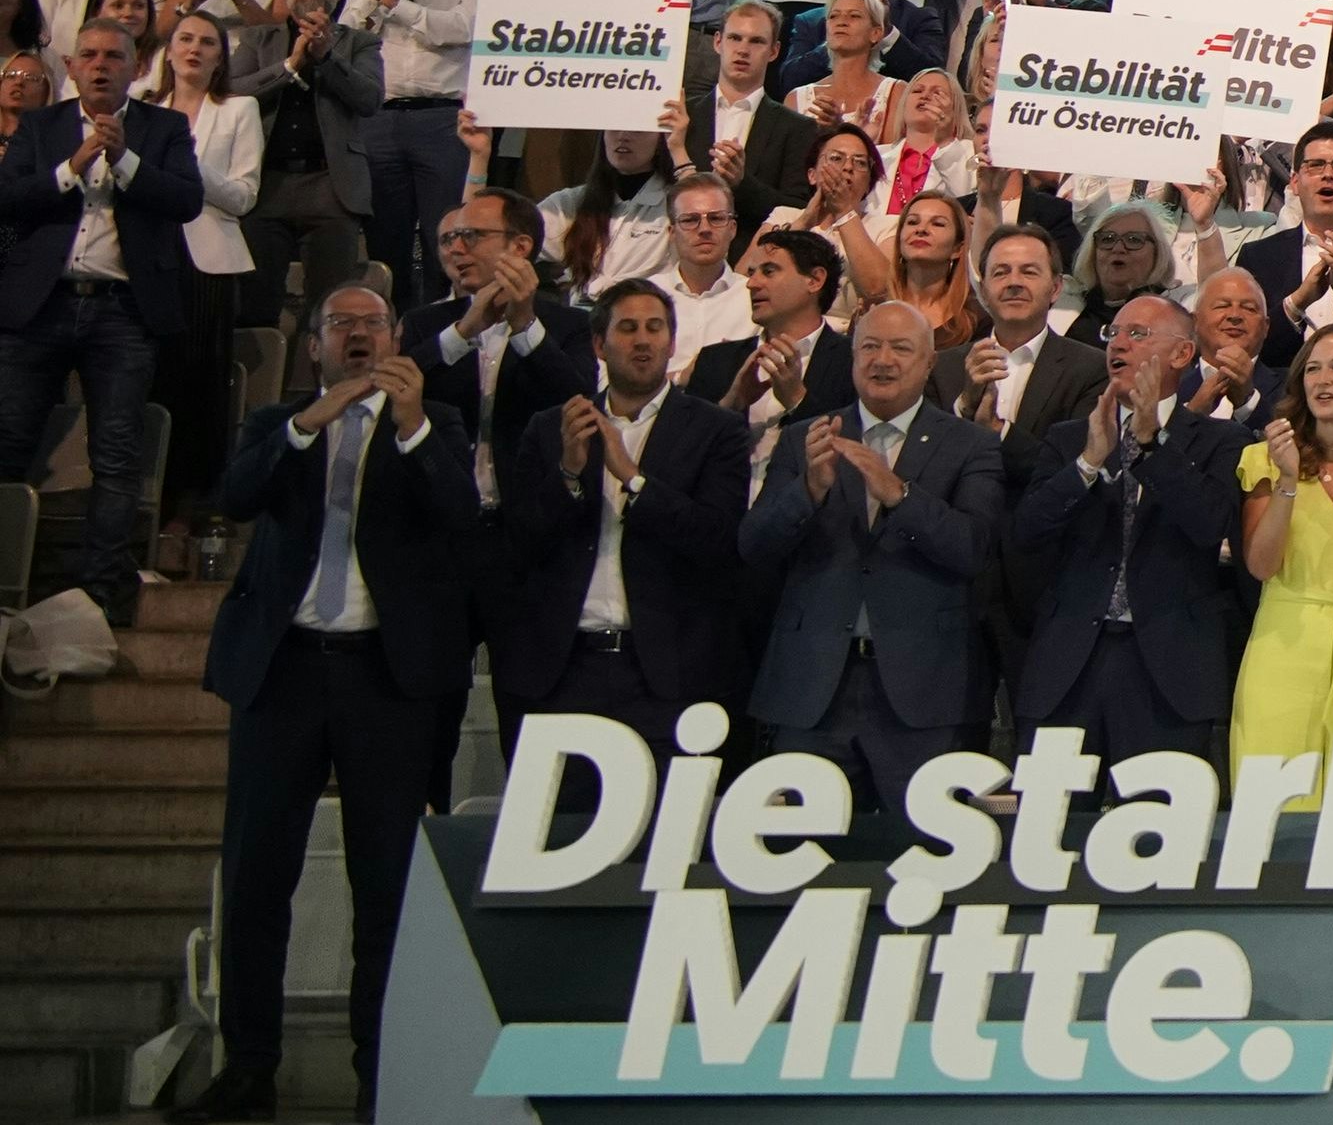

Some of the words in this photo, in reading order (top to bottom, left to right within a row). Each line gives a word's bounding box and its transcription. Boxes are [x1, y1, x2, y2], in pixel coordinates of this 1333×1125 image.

[486, 19, 667, 58] Stabilität
[482, 64, 519, 87] für
[523, 60, 662, 92] Österreich.
[1013, 53, 1206, 103] Stabilität
[1008, 101, 1048, 126] für
[1053, 100, 1201, 141] Österreich.
[481, 701, 853, 893] Die
[616, 877, 1295, 1083] Mitte.
